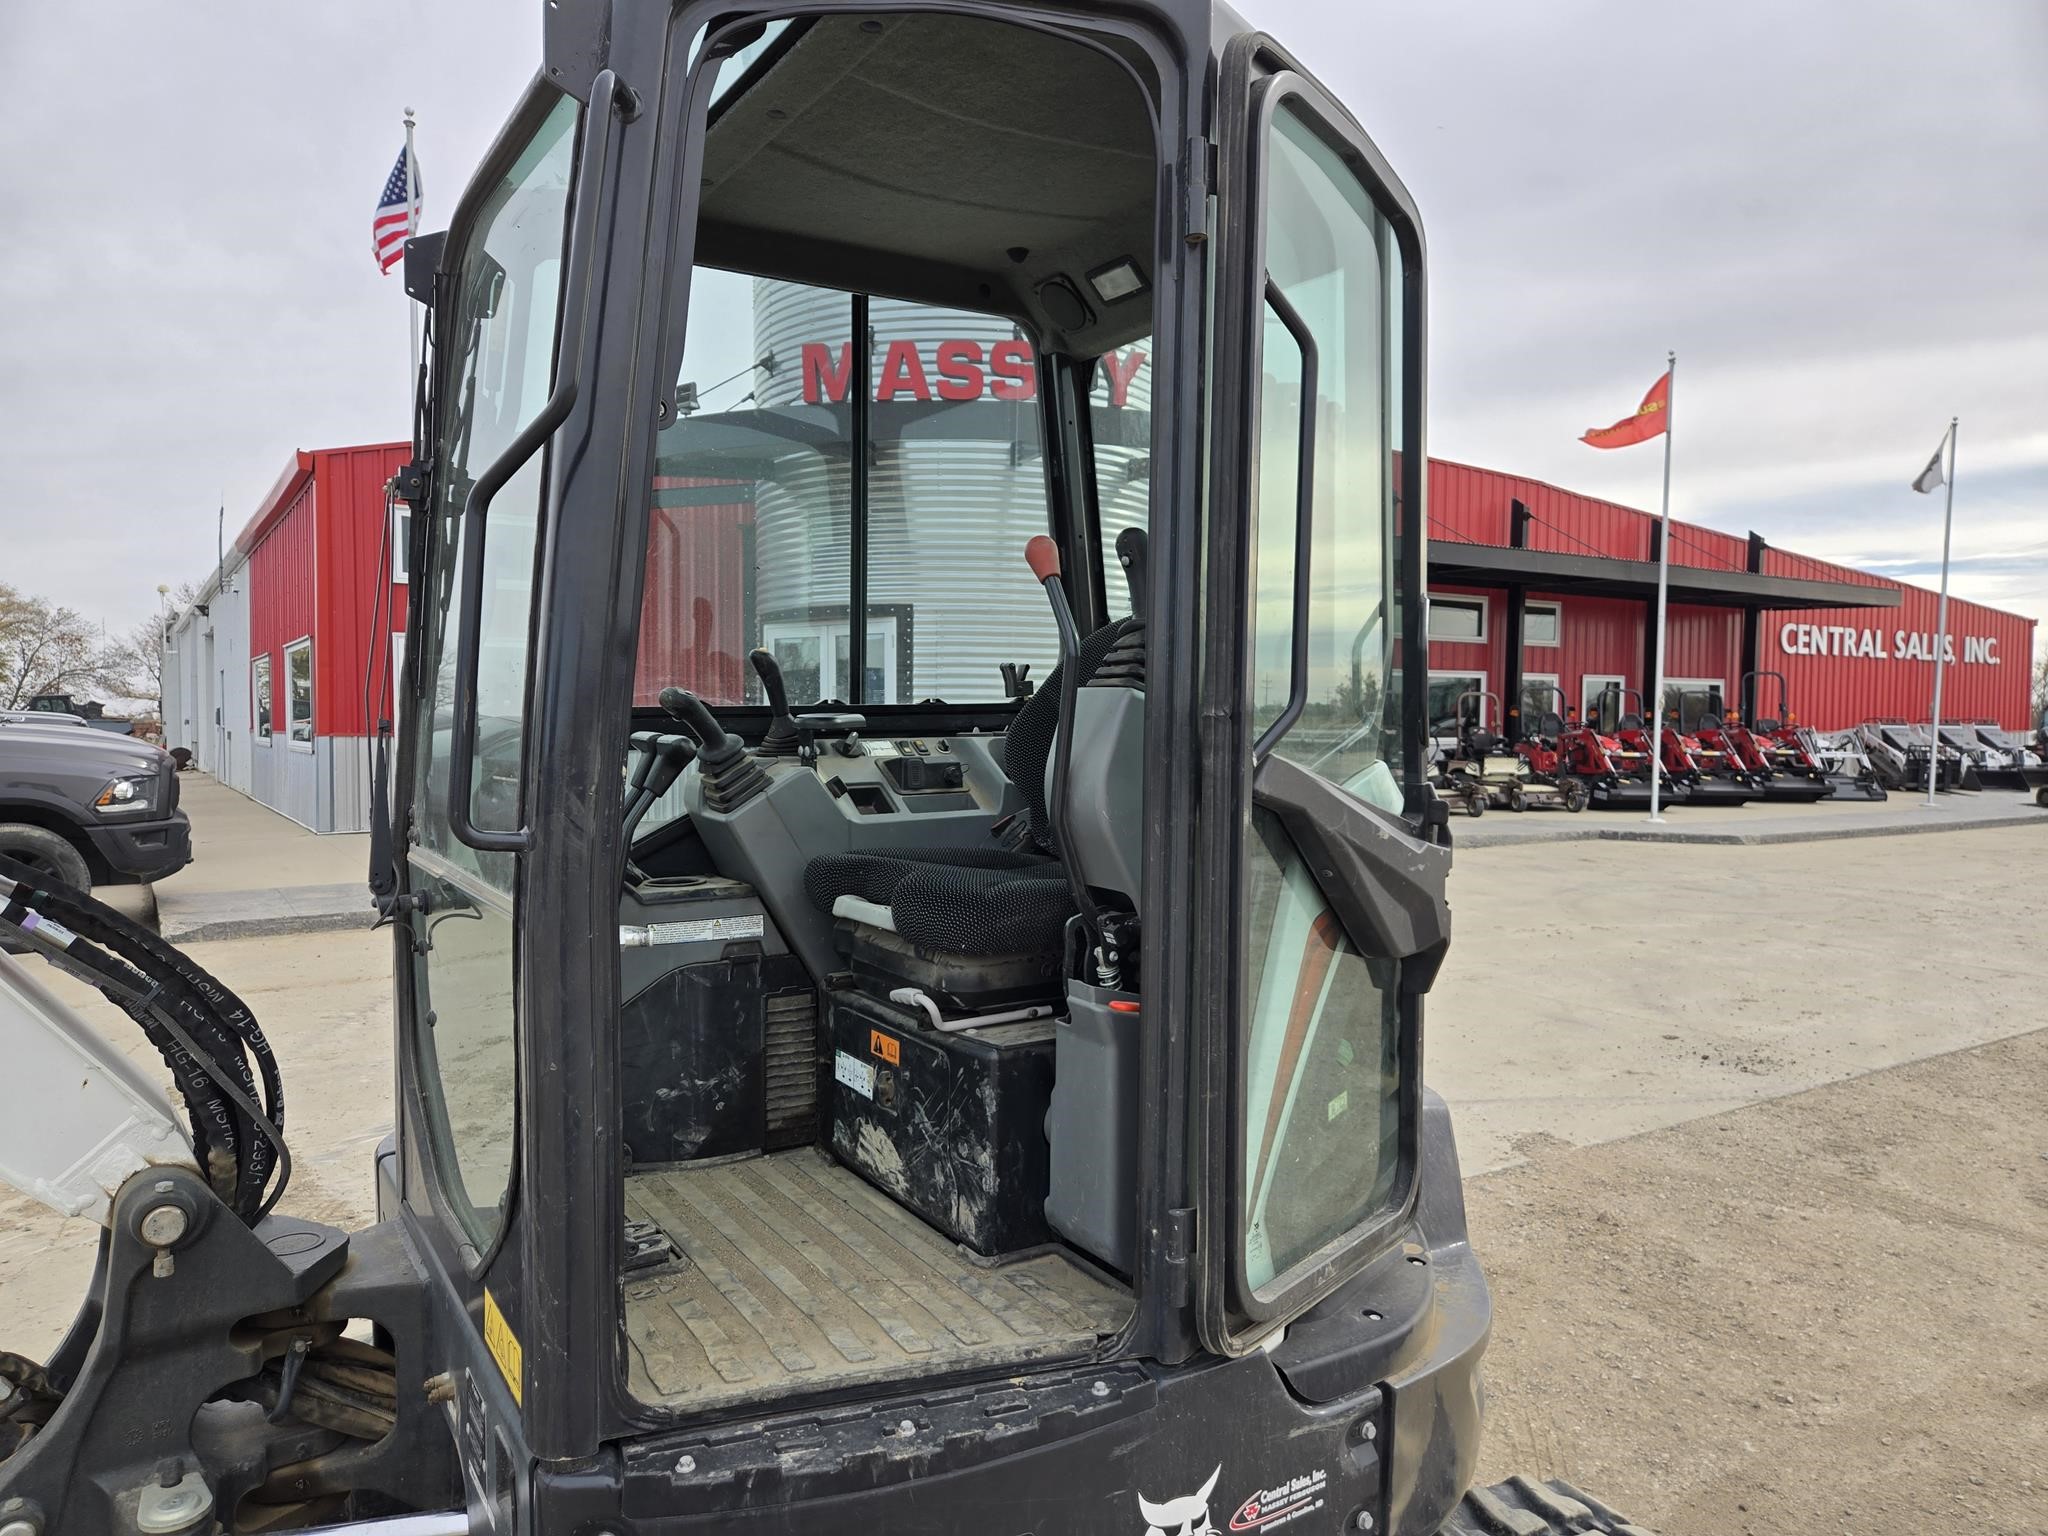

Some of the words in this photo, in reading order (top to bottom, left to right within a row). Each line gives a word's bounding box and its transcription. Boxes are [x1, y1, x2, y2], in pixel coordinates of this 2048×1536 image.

[801, 338, 1148, 408] MASSY
[1780, 622, 1888, 659] CENTRAL
[1963, 636, 2001, 665] INC.
[228, 1008, 272, 1055] HG-14
[166, 1038, 210, 1090] HG-16
[1260, 1480, 1290, 1504] Central
[1290, 1475, 1312, 1492] Sales,
[1312, 1469, 1327, 1483] Inc.
